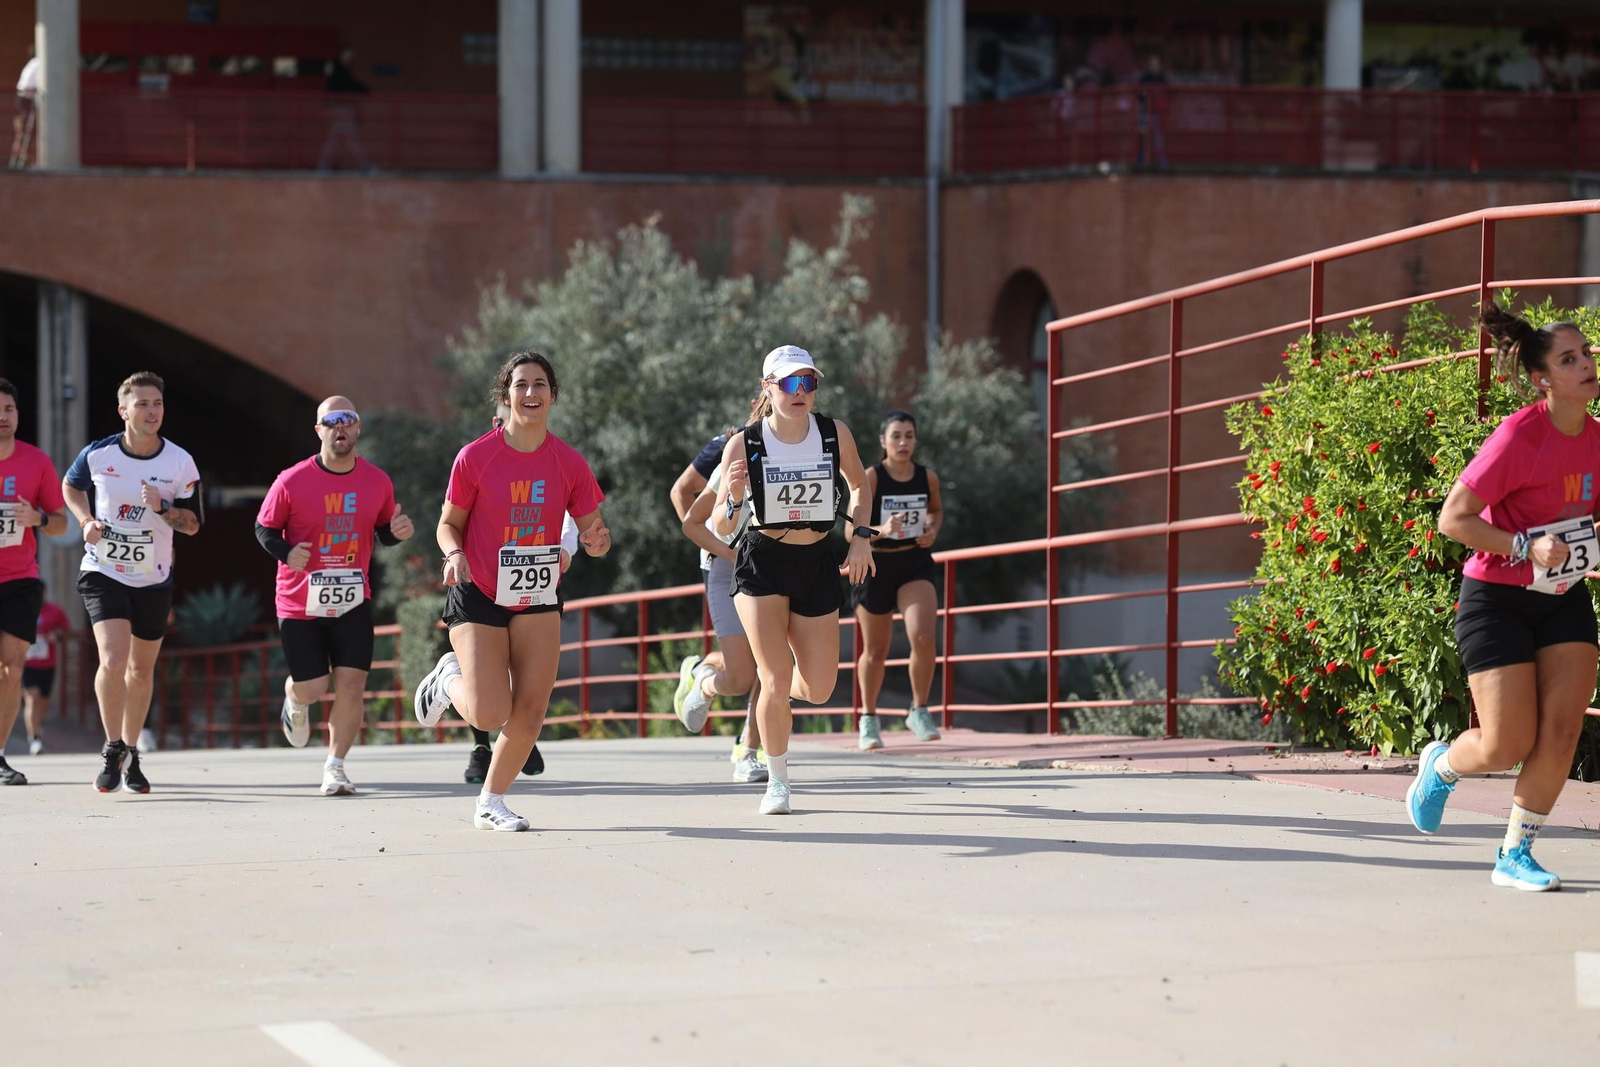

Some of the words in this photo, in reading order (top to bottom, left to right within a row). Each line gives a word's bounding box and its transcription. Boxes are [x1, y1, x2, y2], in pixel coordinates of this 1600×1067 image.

[0, 476, 16, 496] E
[768, 472, 798, 482] UMA
[510, 480, 546, 504] WE
[777, 483, 823, 505] 422
[1564, 473, 1593, 502] WE
[324, 492, 357, 514] WE
[327, 516, 353, 531] RUN
[512, 507, 541, 523] RUN
[891, 510, 919, 525] 43
[102, 530, 124, 542] UMA
[319, 533, 358, 553] UMA
[503, 526, 546, 547] UMA
[107, 542, 145, 562] 226
[503, 557, 531, 566] UMA
[312, 577, 337, 585] UMA
[510, 567, 551, 590] 299
[319, 587, 355, 604] 656
